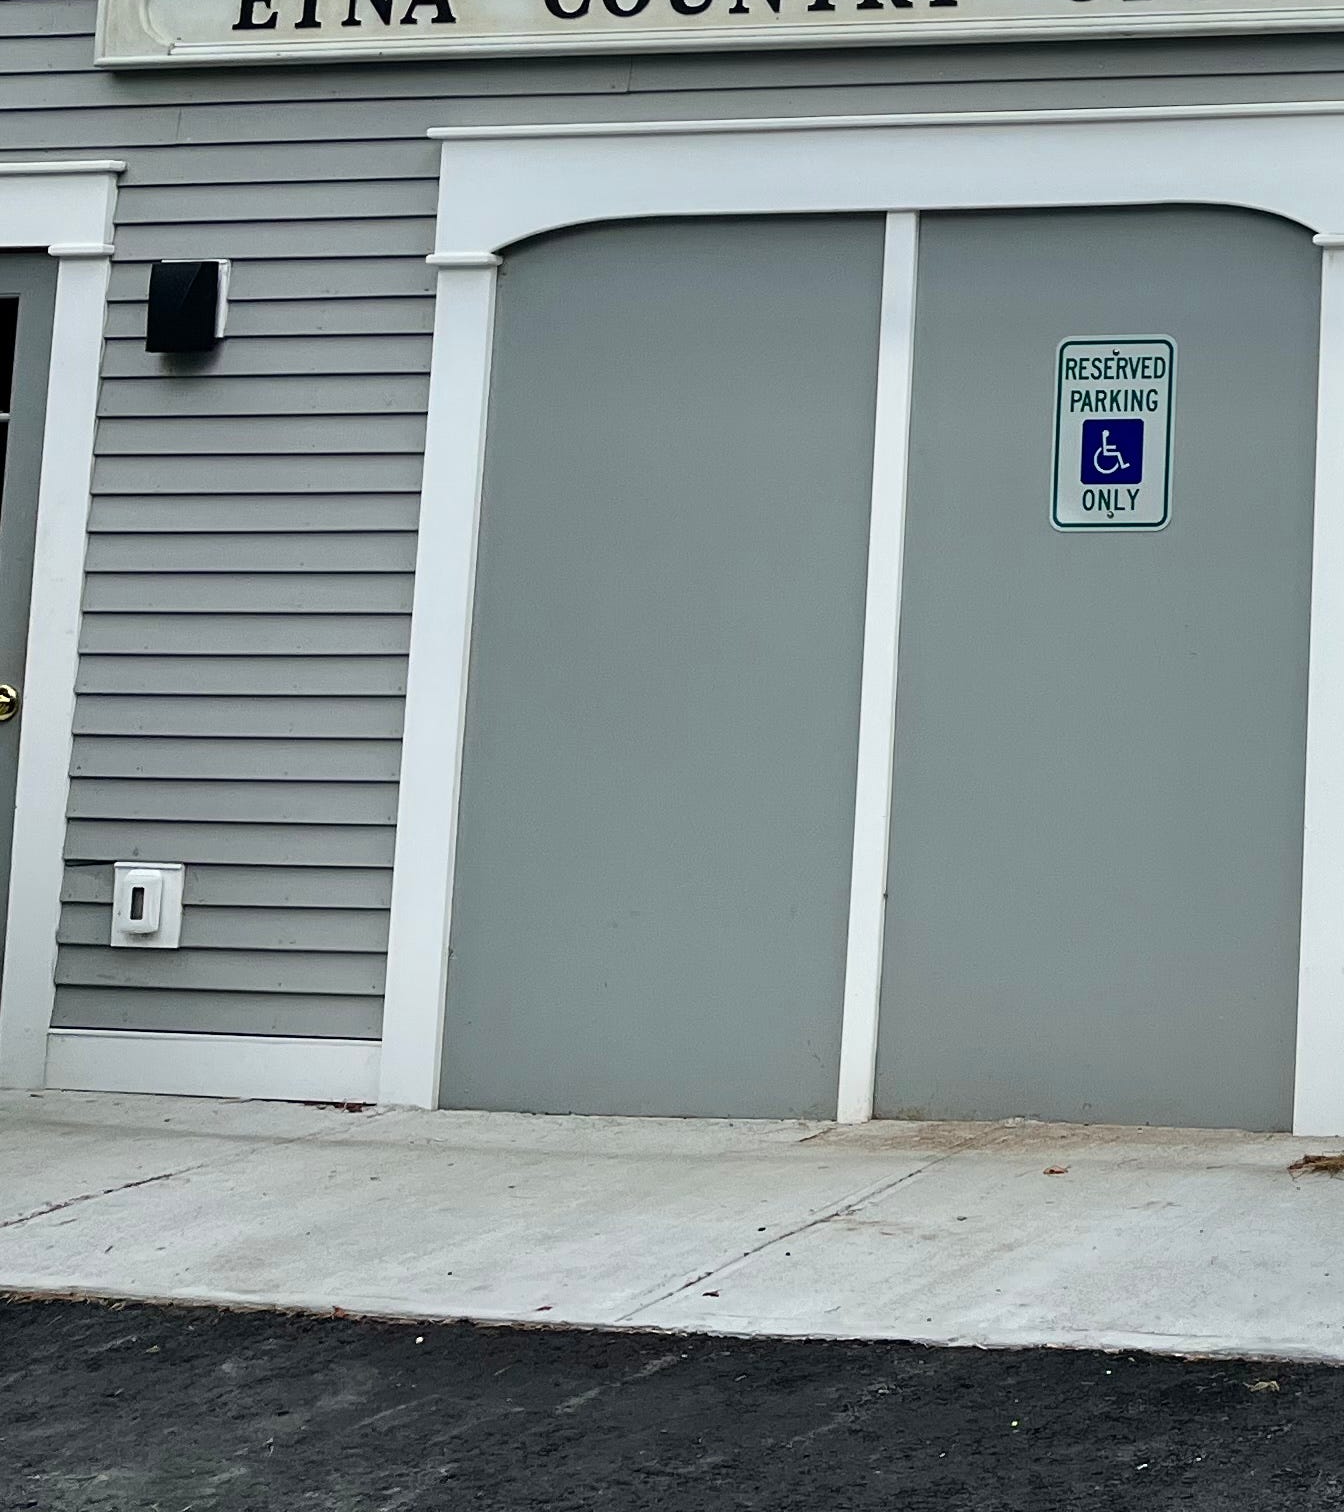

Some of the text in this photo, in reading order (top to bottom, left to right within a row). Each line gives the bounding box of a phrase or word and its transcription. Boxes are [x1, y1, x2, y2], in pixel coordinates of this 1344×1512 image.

[1064, 356, 1166, 381] RESERVED
[1070, 388, 1159, 413] PARKING
[1082, 488, 1140, 512] ONLY
